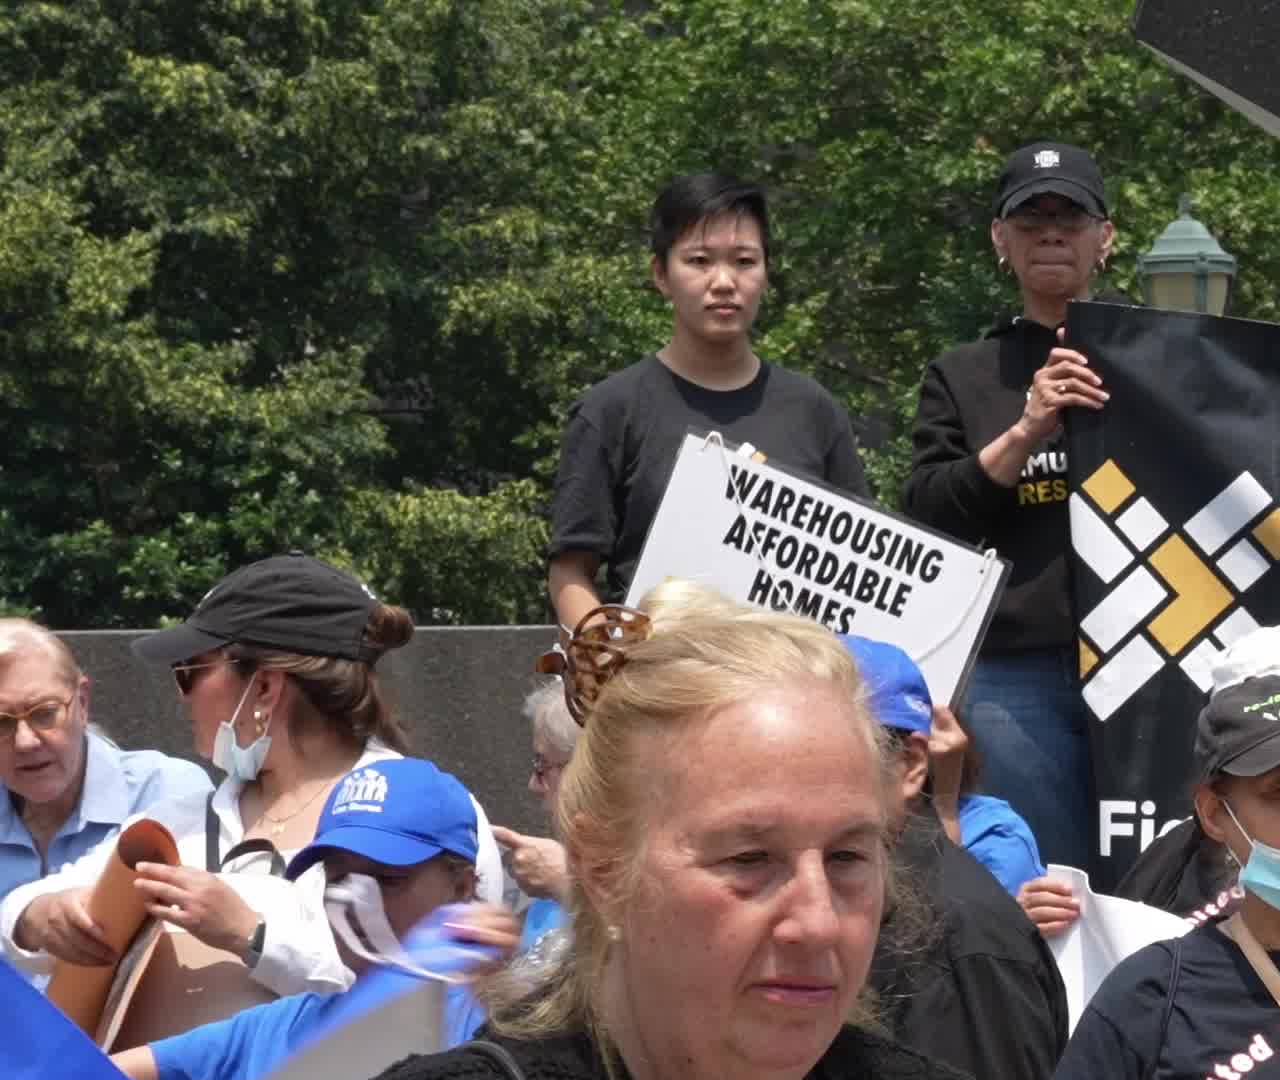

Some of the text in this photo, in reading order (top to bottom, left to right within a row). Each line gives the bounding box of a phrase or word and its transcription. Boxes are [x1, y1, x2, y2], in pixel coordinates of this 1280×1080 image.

[725, 465, 944, 584] WAREHOUSING
[1019, 479, 1068, 505] RES
[723, 514, 912, 618] AFFORDABLE
[747, 569, 856, 636] HOMES
